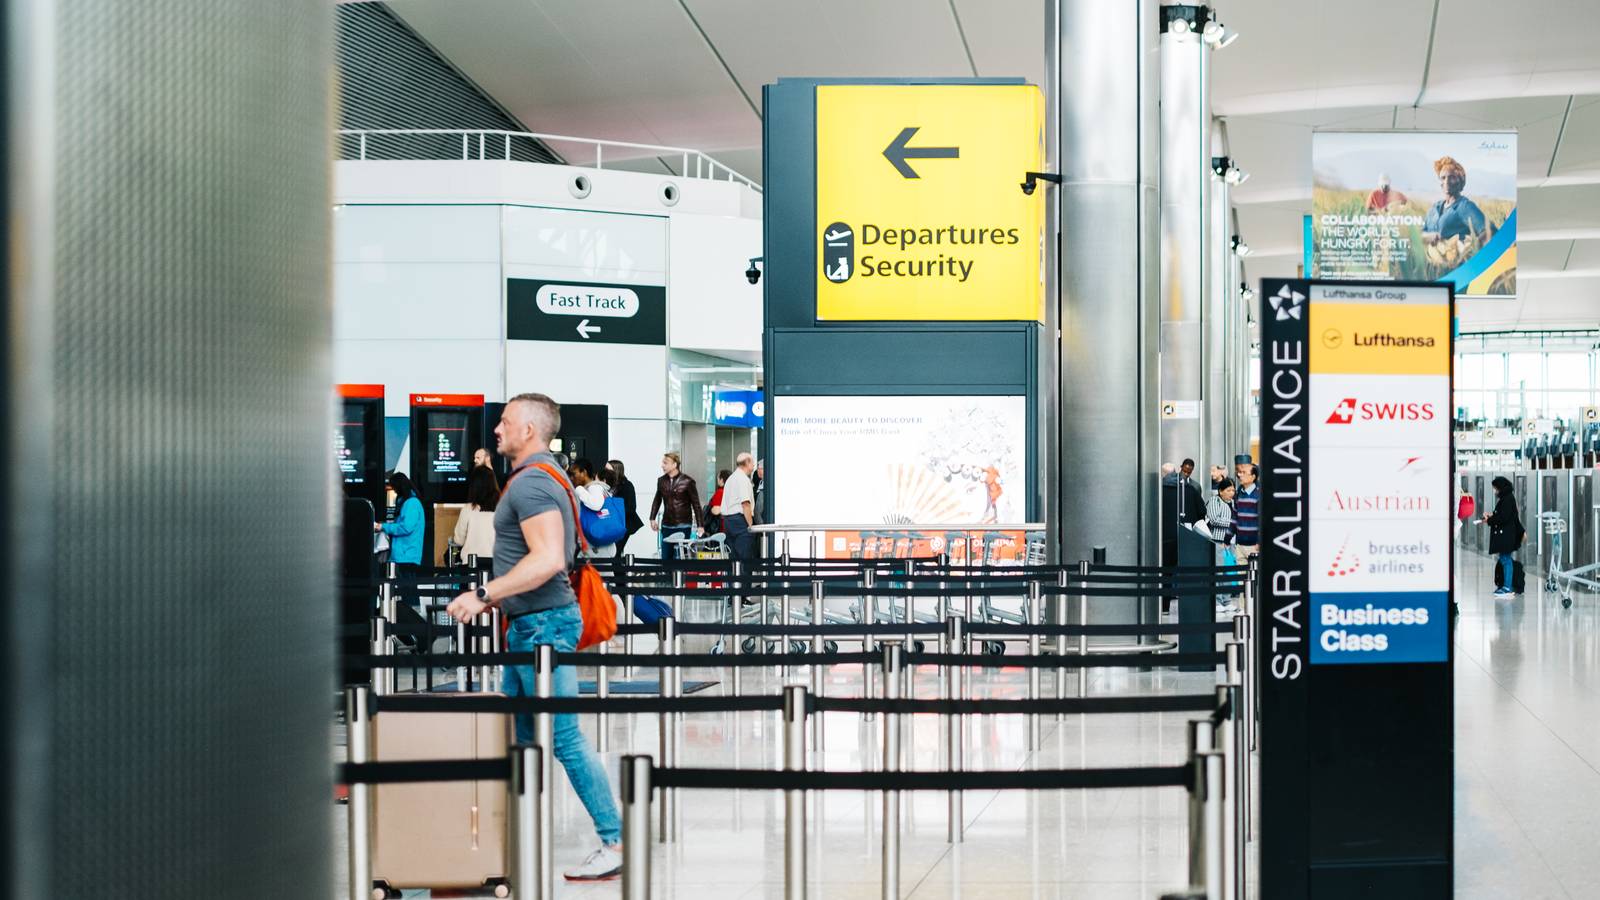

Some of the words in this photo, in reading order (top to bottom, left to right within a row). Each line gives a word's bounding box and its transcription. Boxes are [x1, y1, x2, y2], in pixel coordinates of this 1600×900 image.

[1320, 215, 1425, 225] COLLABORATION.
[861, 224, 1019, 250] Departures
[1321, 226, 1344, 237] THE
[1347, 226, 1400, 237] WORLD'S
[1320, 238, 1371, 249] HUNGRY
[1373, 238, 1397, 249] FOR
[1398, 238, 1411, 249] IT.
[861, 254, 974, 282] Security
[550, 293, 581, 308] Fast
[586, 295, 626, 310] Track
[1323, 289, 1372, 299] Lufthansa
[1375, 290, 1407, 300] Group
[1353, 332, 1435, 348] Lufthansa
[804, 416, 829, 424] MORE
[831, 416, 863, 424] BEAUTY
[880, 416, 923, 424] DISCOVER
[1361, 402, 1434, 421] SWISS
[1272, 339, 1302, 556] ALLIANCE
[1327, 488, 1431, 511] Austrian
[1368, 541, 1431, 555] brussels
[1368, 563, 1425, 575] airlines
[1320, 603, 1429, 626] Business
[1271, 569, 1302, 680] STAR
[1320, 629, 1389, 652] Class
